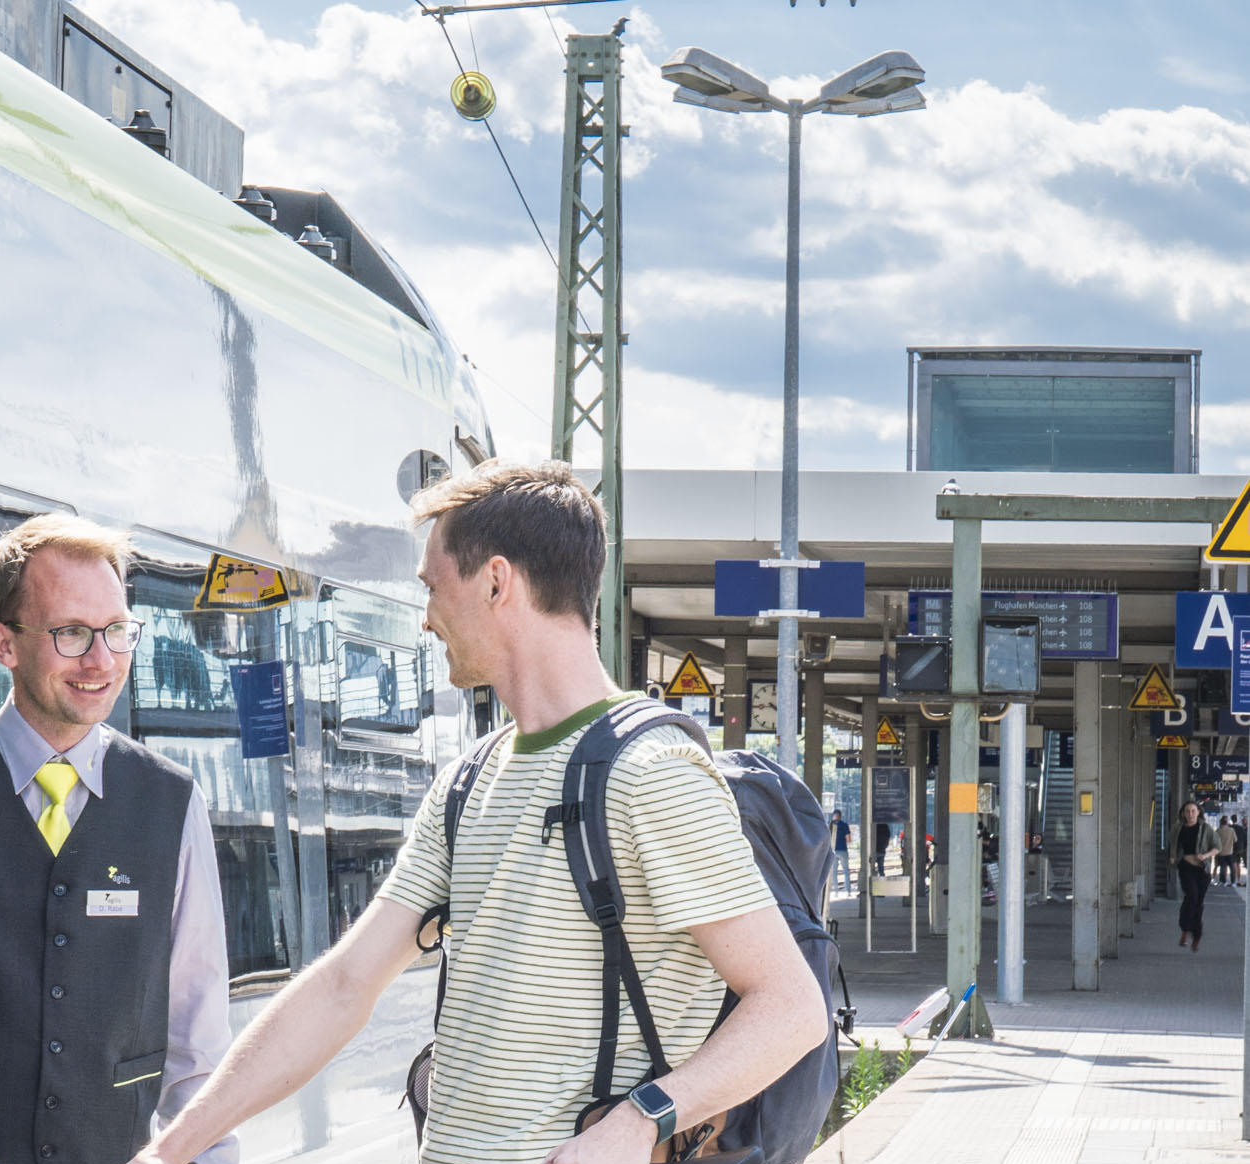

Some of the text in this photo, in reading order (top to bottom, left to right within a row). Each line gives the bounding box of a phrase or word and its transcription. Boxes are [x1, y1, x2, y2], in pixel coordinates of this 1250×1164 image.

[994, 600, 1093, 611] Flughafen München 108
[1078, 615, 1093, 623] 108
[1193, 594, 1234, 651] A
[1078, 628, 1093, 636] 108
[1078, 641, 1093, 649] 108
[1164, 693, 1188, 726] B
[1191, 755, 1201, 769] 8
